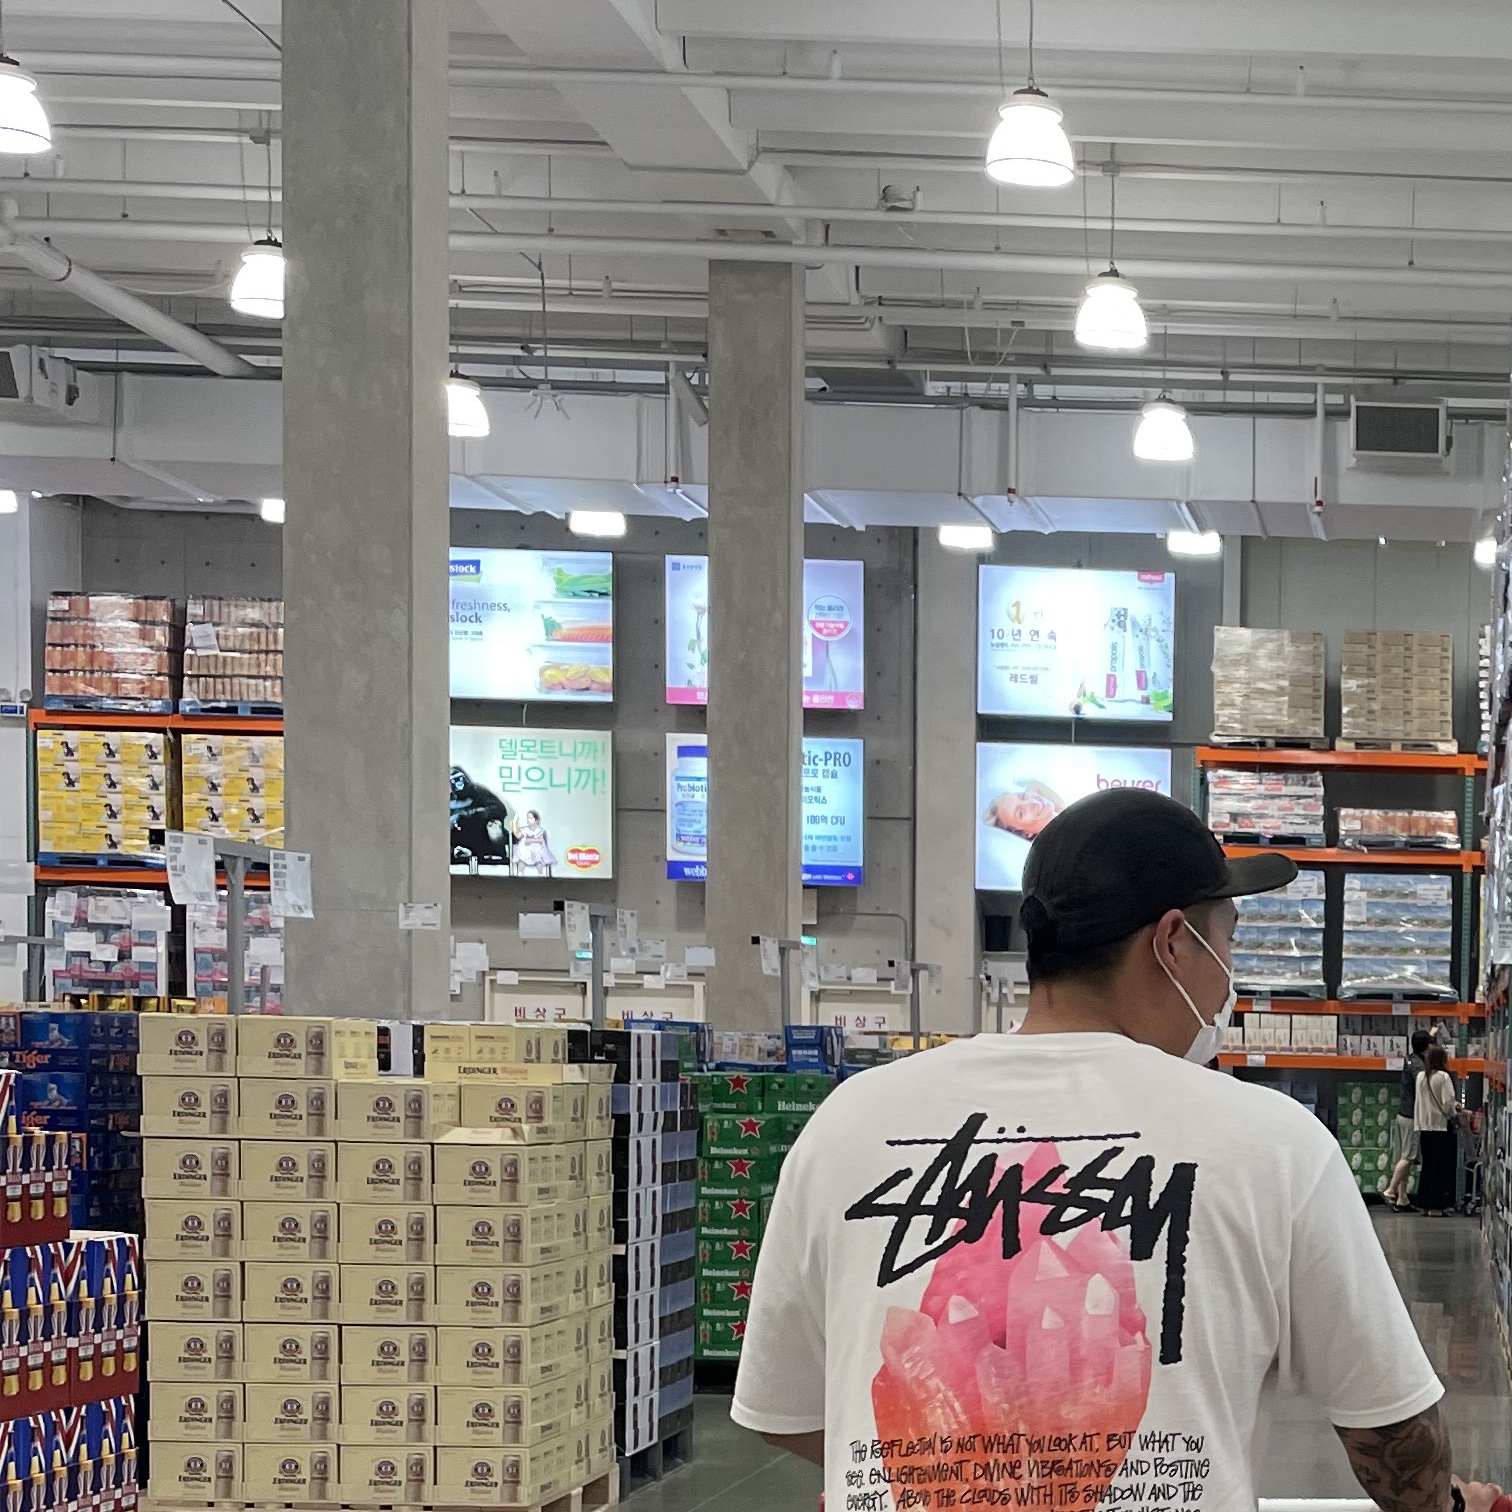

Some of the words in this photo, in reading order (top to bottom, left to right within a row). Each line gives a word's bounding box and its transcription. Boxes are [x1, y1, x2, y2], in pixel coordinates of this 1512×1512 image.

[451, 598, 511, 613] freshness,
[499, 738, 606, 763] 델몬트니까!
[499, 765, 607, 797] 믿으니까!
[12, 1049, 52, 1070] Tiger
[457, 1064, 499, 1076] ERDINGER
[21, 1110, 51, 1128] iger
[940, 1435, 953, 1453] IS
[957, 1434, 978, 1453] NOT
[982, 1433, 1027, 1454] WHAT
[1025, 1434, 1046, 1457] YOU
[1049, 1434, 1078, 1452] LOOK
[1106, 1431, 1137, 1451] BUT
[1138, 1431, 1182, 1453] WHAT
[1182, 1435, 1205, 1453] YOU
[973, 1458, 1023, 1481] DIVINE
[1028, 1458, 1118, 1478] VIBRATIONS
[1118, 1458, 1151, 1477] AND
[934, 1487, 957, 1508] THE
[960, 1487, 1012, 1507] CLOUDS
[1015, 1481, 1054, 1507] WITH
[1058, 1481, 1080, 1505] ITS
[1082, 1482, 1147, 1504] SHADOW
[1148, 1483, 1179, 1502] AND
[1177, 1481, 1204, 1503] THE
